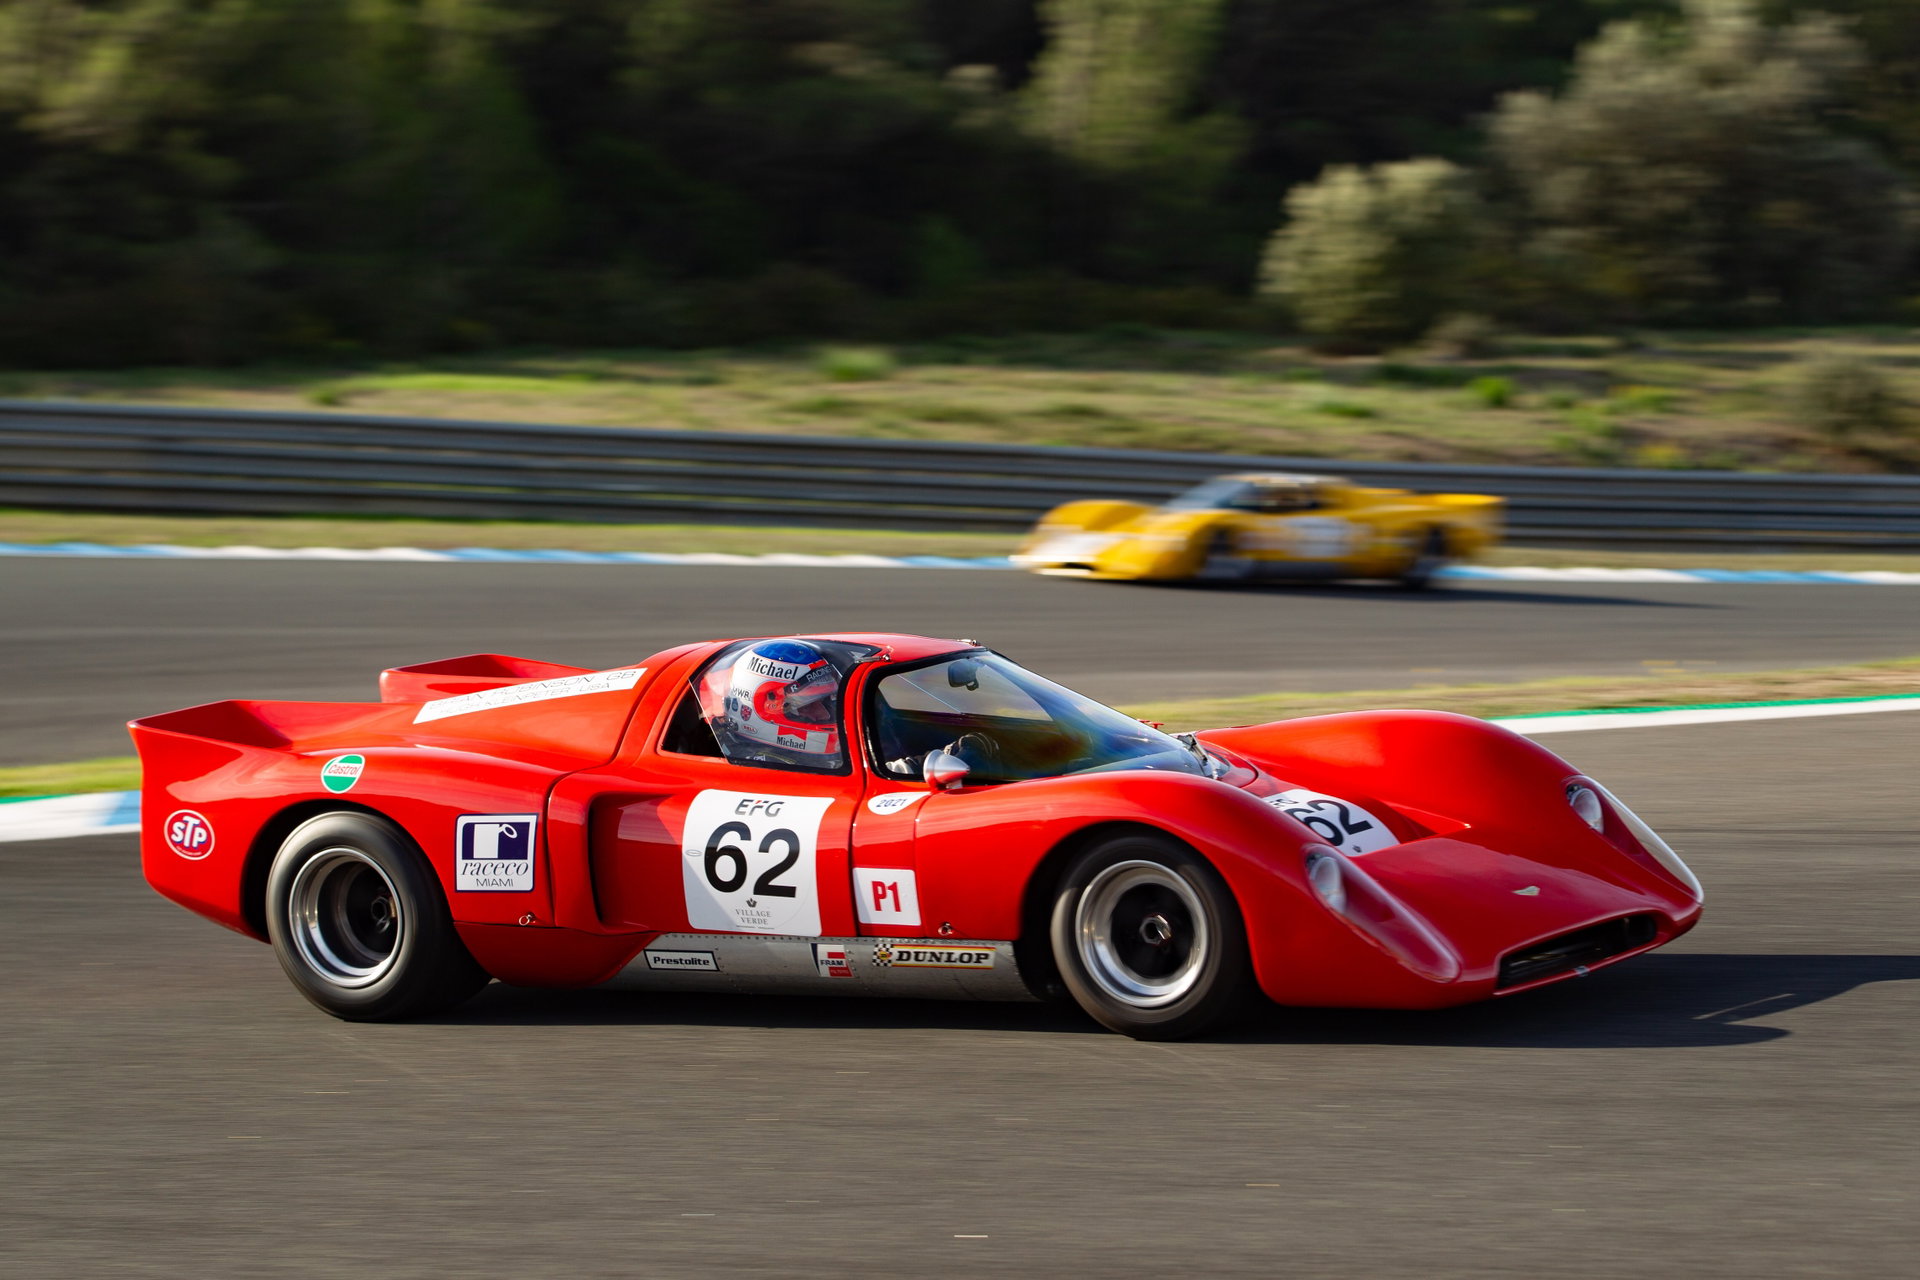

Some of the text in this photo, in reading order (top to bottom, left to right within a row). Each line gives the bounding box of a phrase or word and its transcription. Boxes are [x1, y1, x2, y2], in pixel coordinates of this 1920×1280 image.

[748, 657, 799, 680] Michael
[606, 671, 636, 681] GB
[776, 736, 806, 750] Michael
[328, 764, 361, 775] Castrol
[735, 799, 784, 817] EFG
[876, 798, 907, 808] 2021
[1284, 800, 1374, 846] 62
[170, 815, 207, 848] STP
[704, 821, 799, 898] 62
[461, 862, 529, 876] raceco
[476, 878, 513, 888] MIAMI
[871, 881, 901, 912] P1
[735, 909, 772, 918] VILLAGE
[740, 917, 769, 925] VERDE
[653, 956, 710, 966] Prestolite
[896, 950, 989, 964] DUNLOP
